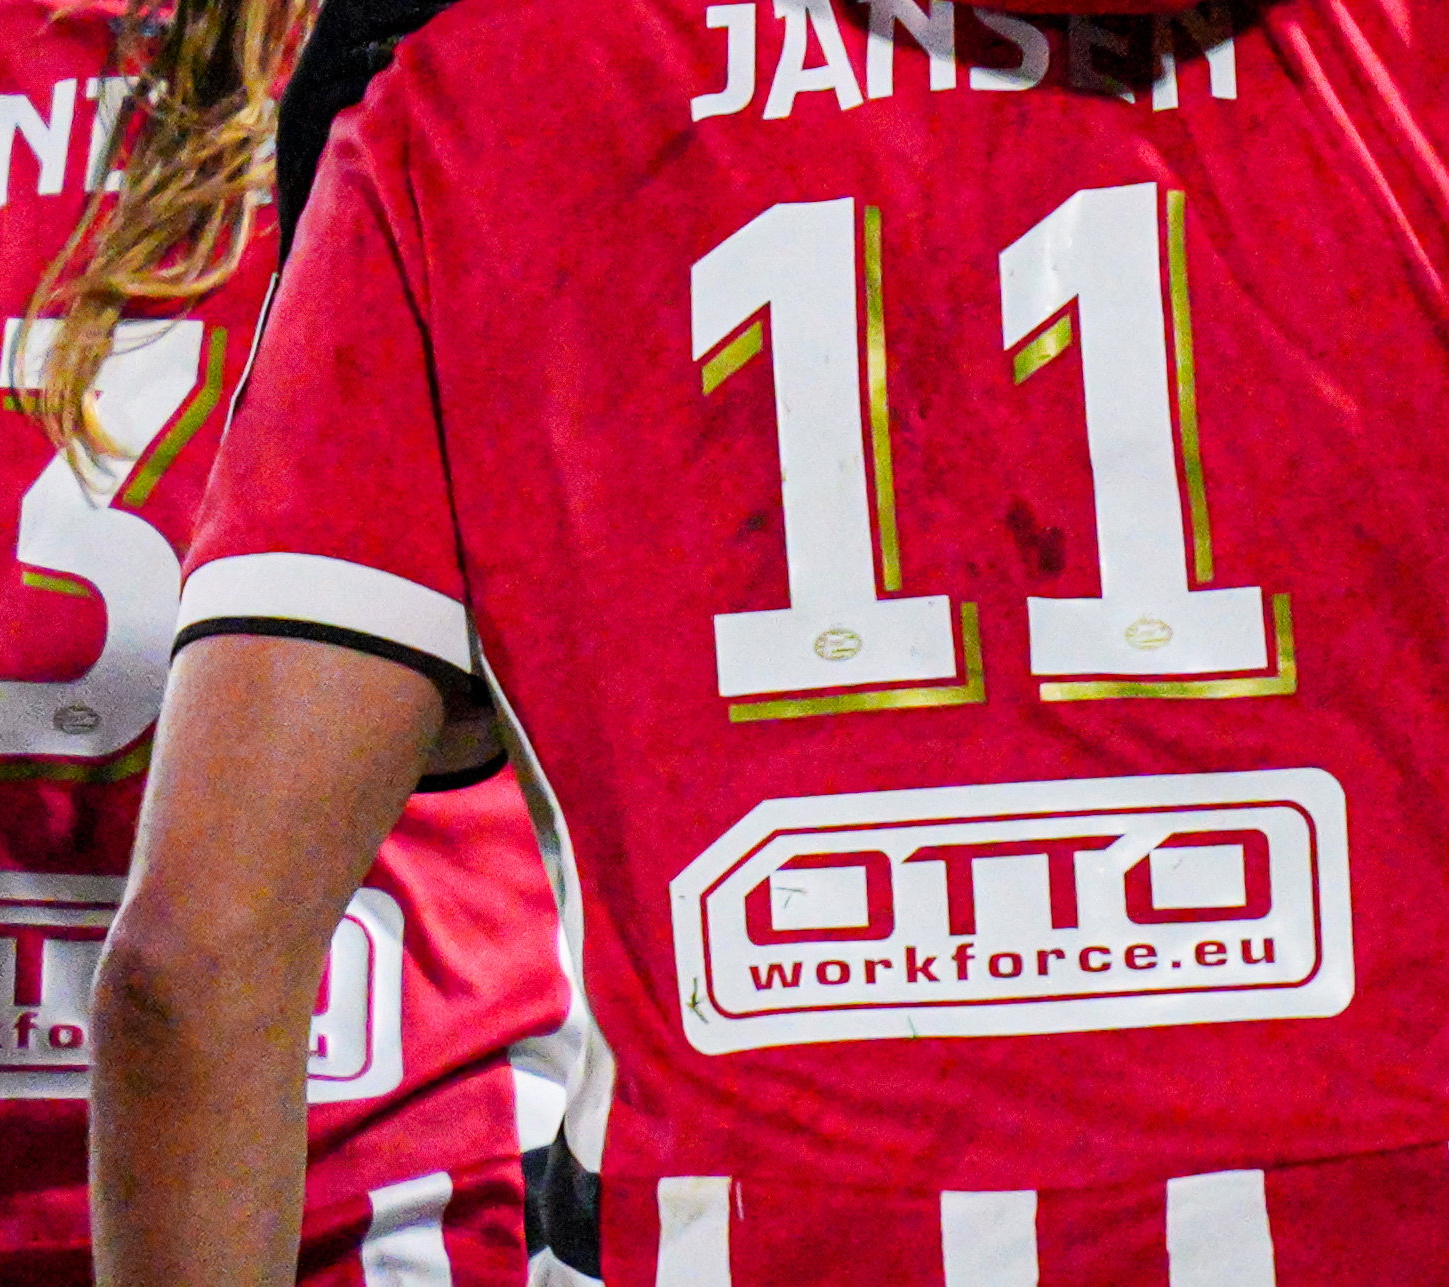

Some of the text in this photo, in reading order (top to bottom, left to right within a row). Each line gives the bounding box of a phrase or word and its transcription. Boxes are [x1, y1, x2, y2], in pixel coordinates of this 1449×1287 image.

[691, 182, 1297, 722] 11
[745, 828, 1270, 946] OTTO
[750, 934, 1276, 993] workforce.eu
